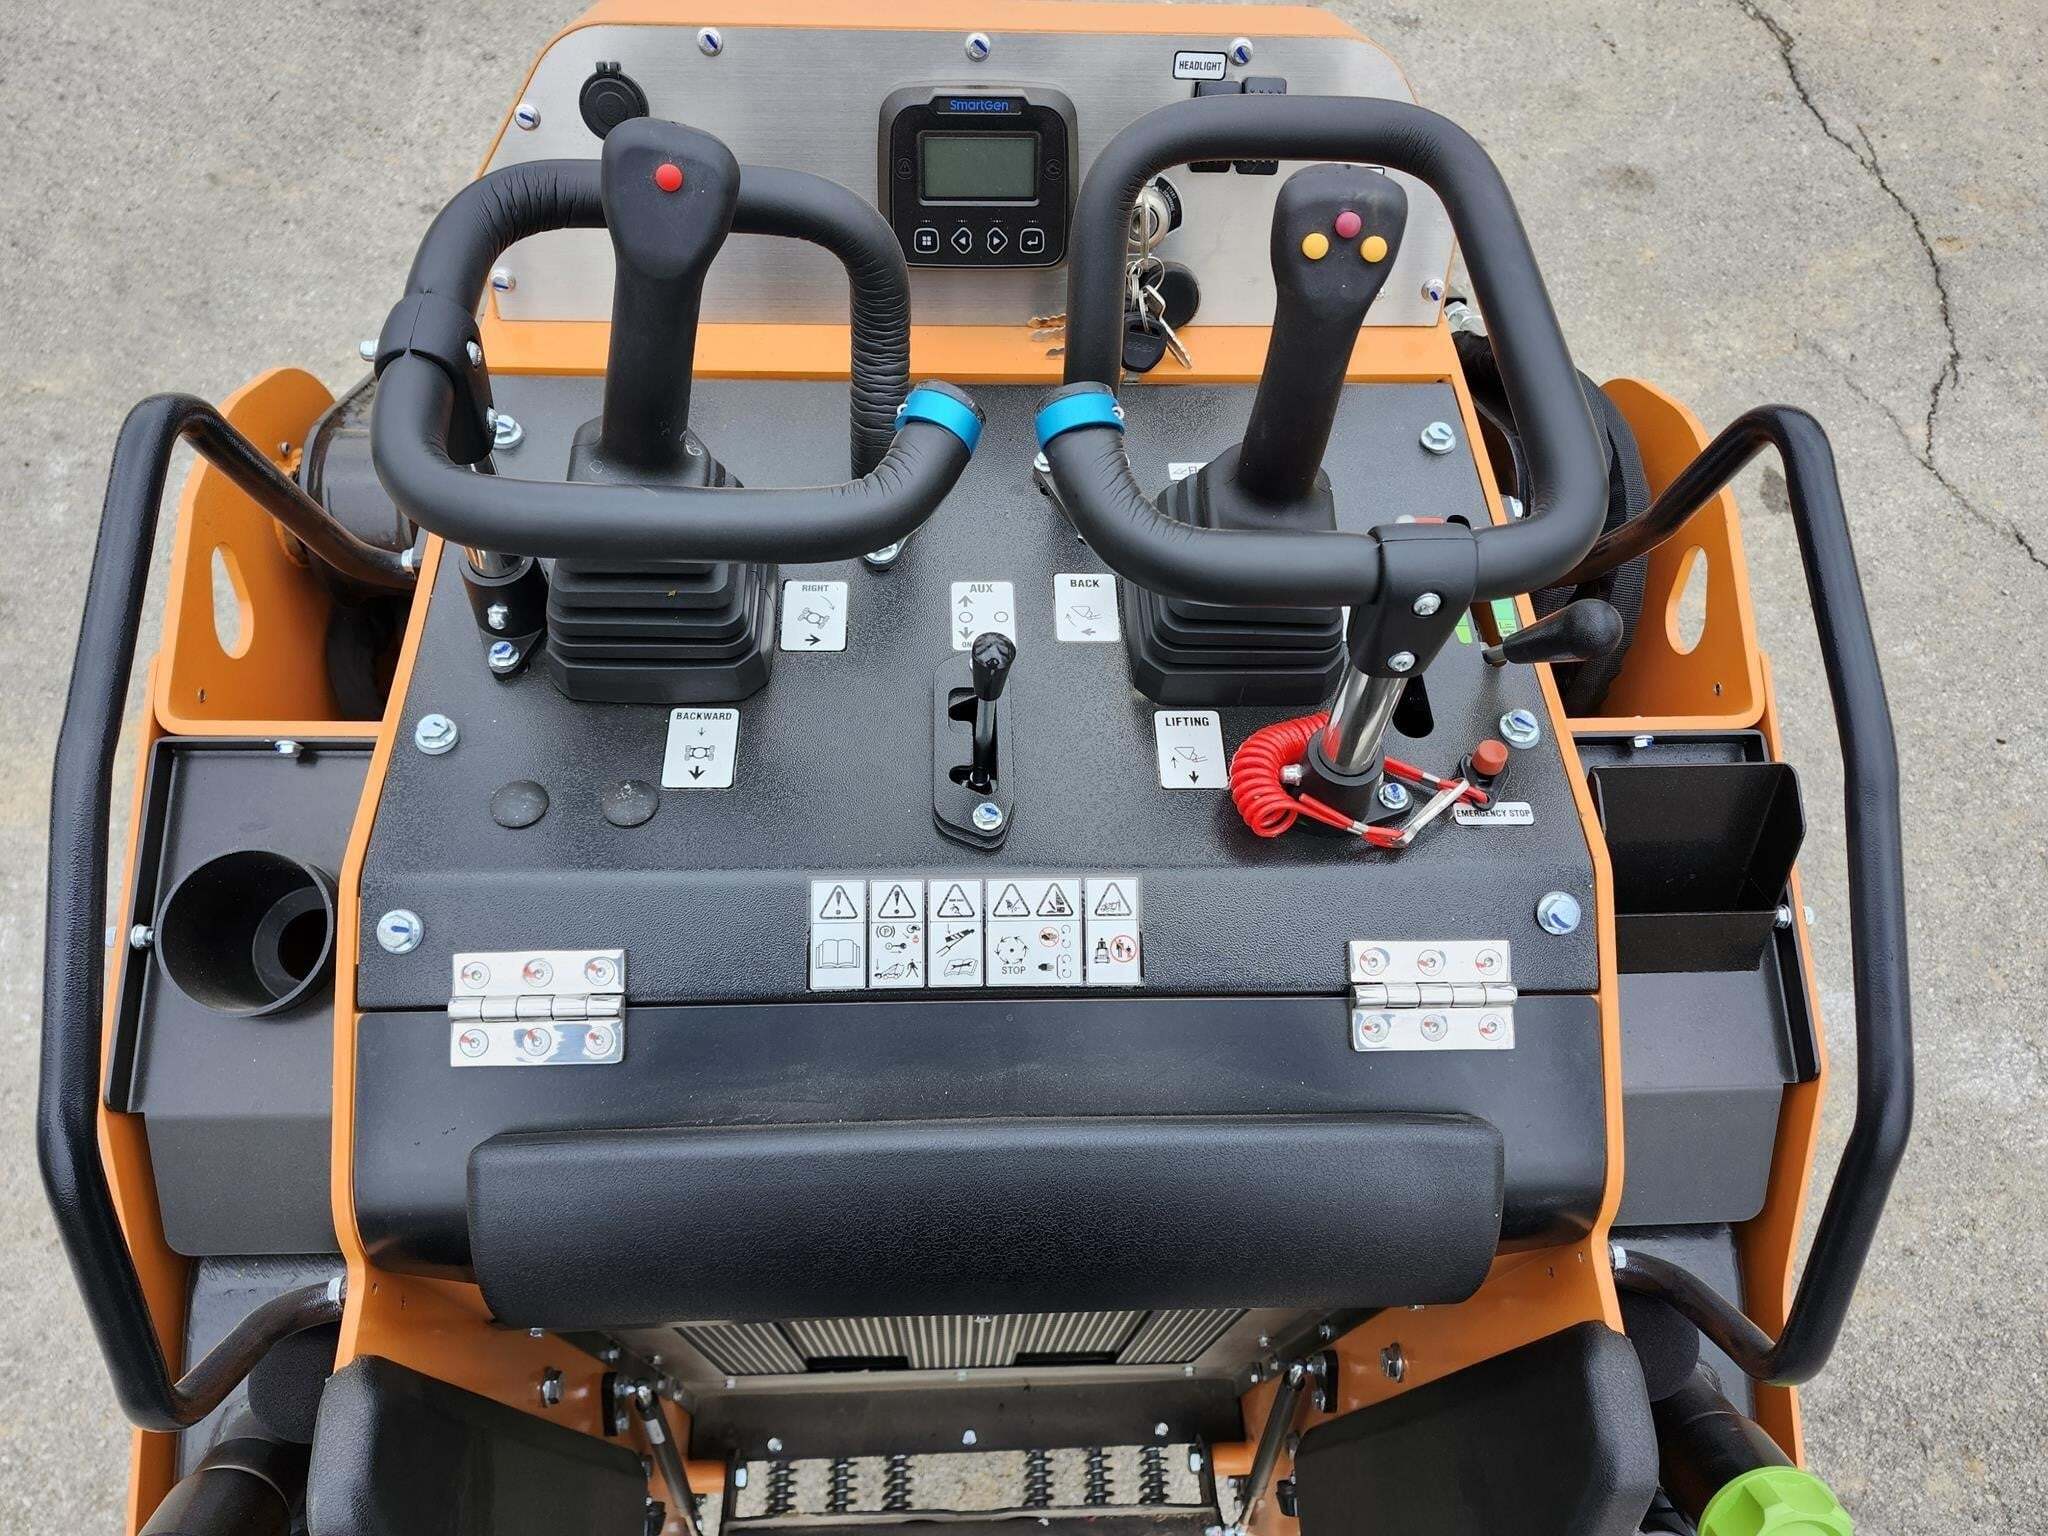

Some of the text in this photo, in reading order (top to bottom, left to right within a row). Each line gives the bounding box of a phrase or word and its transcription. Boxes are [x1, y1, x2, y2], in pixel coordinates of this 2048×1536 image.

[1179, 61, 1222, 71] HEADLIGHT
[950, 99, 1009, 111] SmartGen
[802, 584, 829, 592] RIGHT
[970, 583, 993, 593] AUX
[1070, 579, 1100, 588] BACK
[676, 711, 732, 720] BACKWARD
[1165, 716, 1210, 727] LIFTING
[1456, 809, 1530, 818] EMERGENCY STOP
[1001, 966, 1026, 975] STOP
